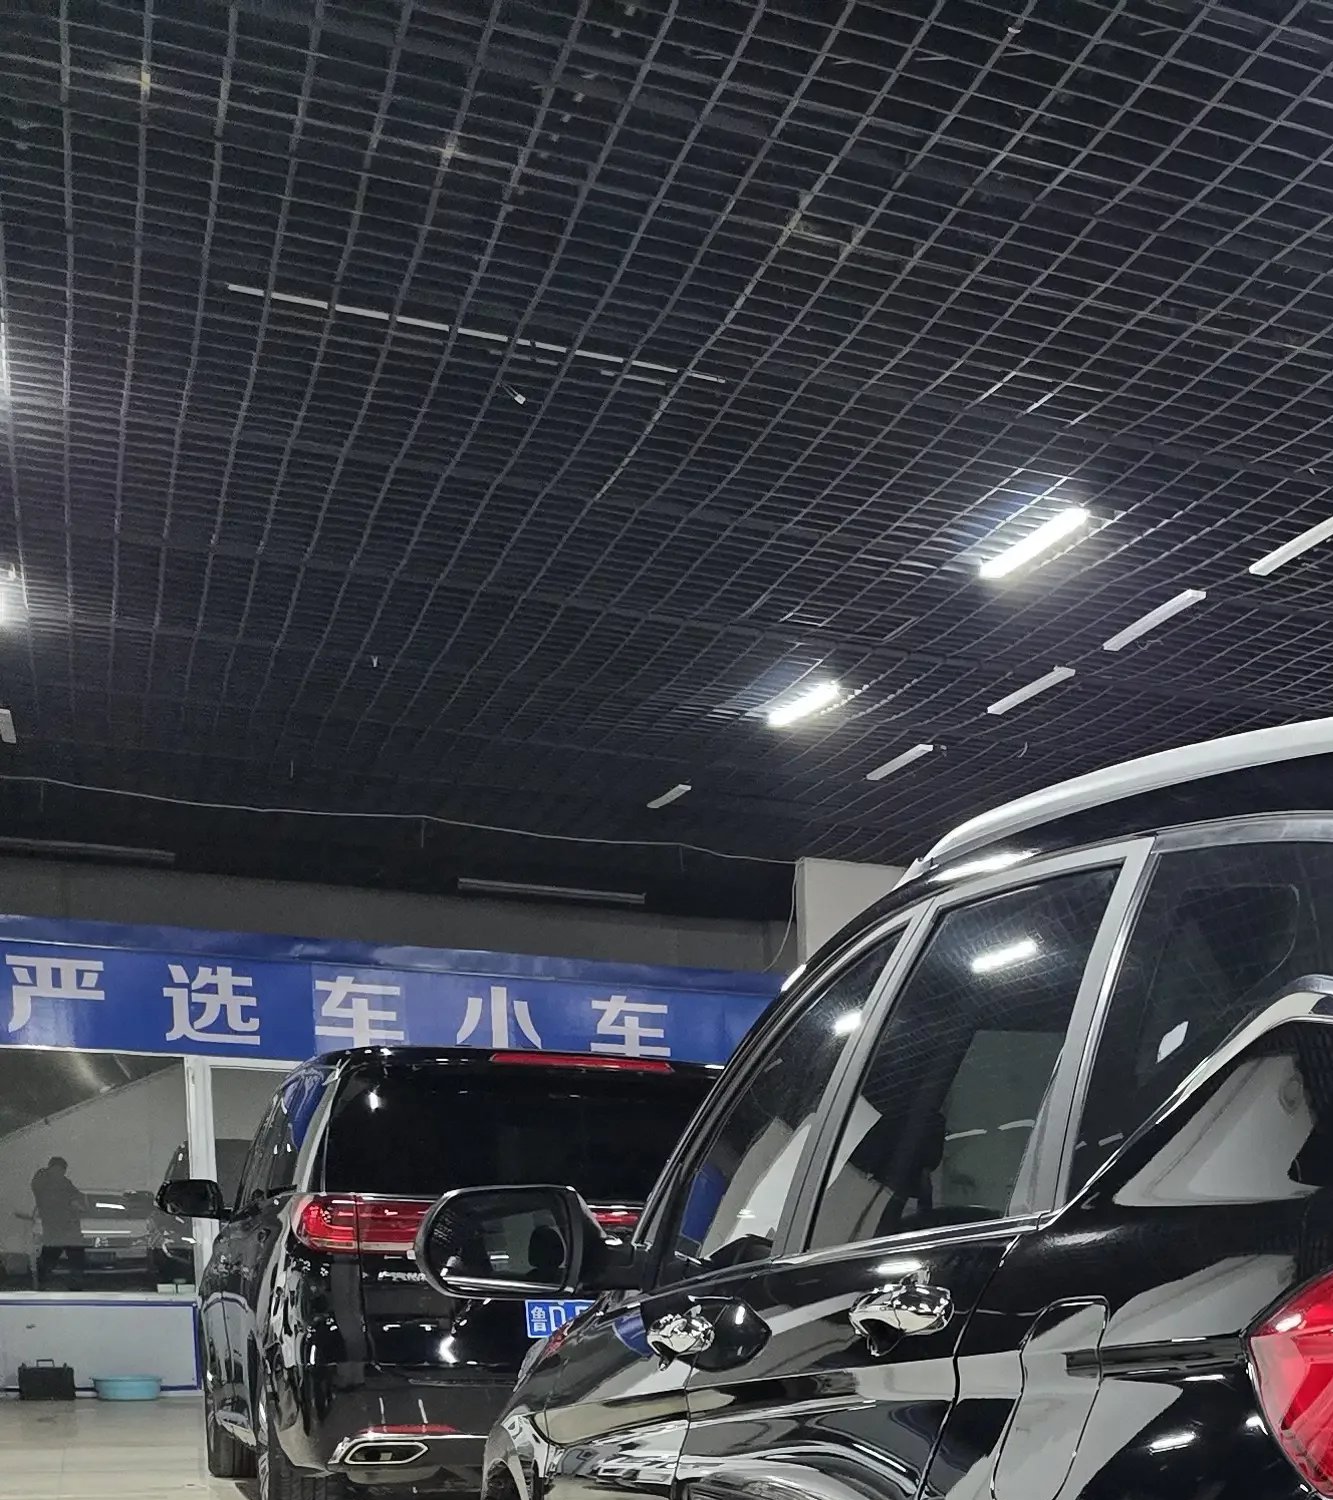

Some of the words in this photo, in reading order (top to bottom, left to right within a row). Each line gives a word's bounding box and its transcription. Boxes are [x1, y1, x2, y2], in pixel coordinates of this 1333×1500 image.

[4, 954, 672, 1058] 严选车小车
